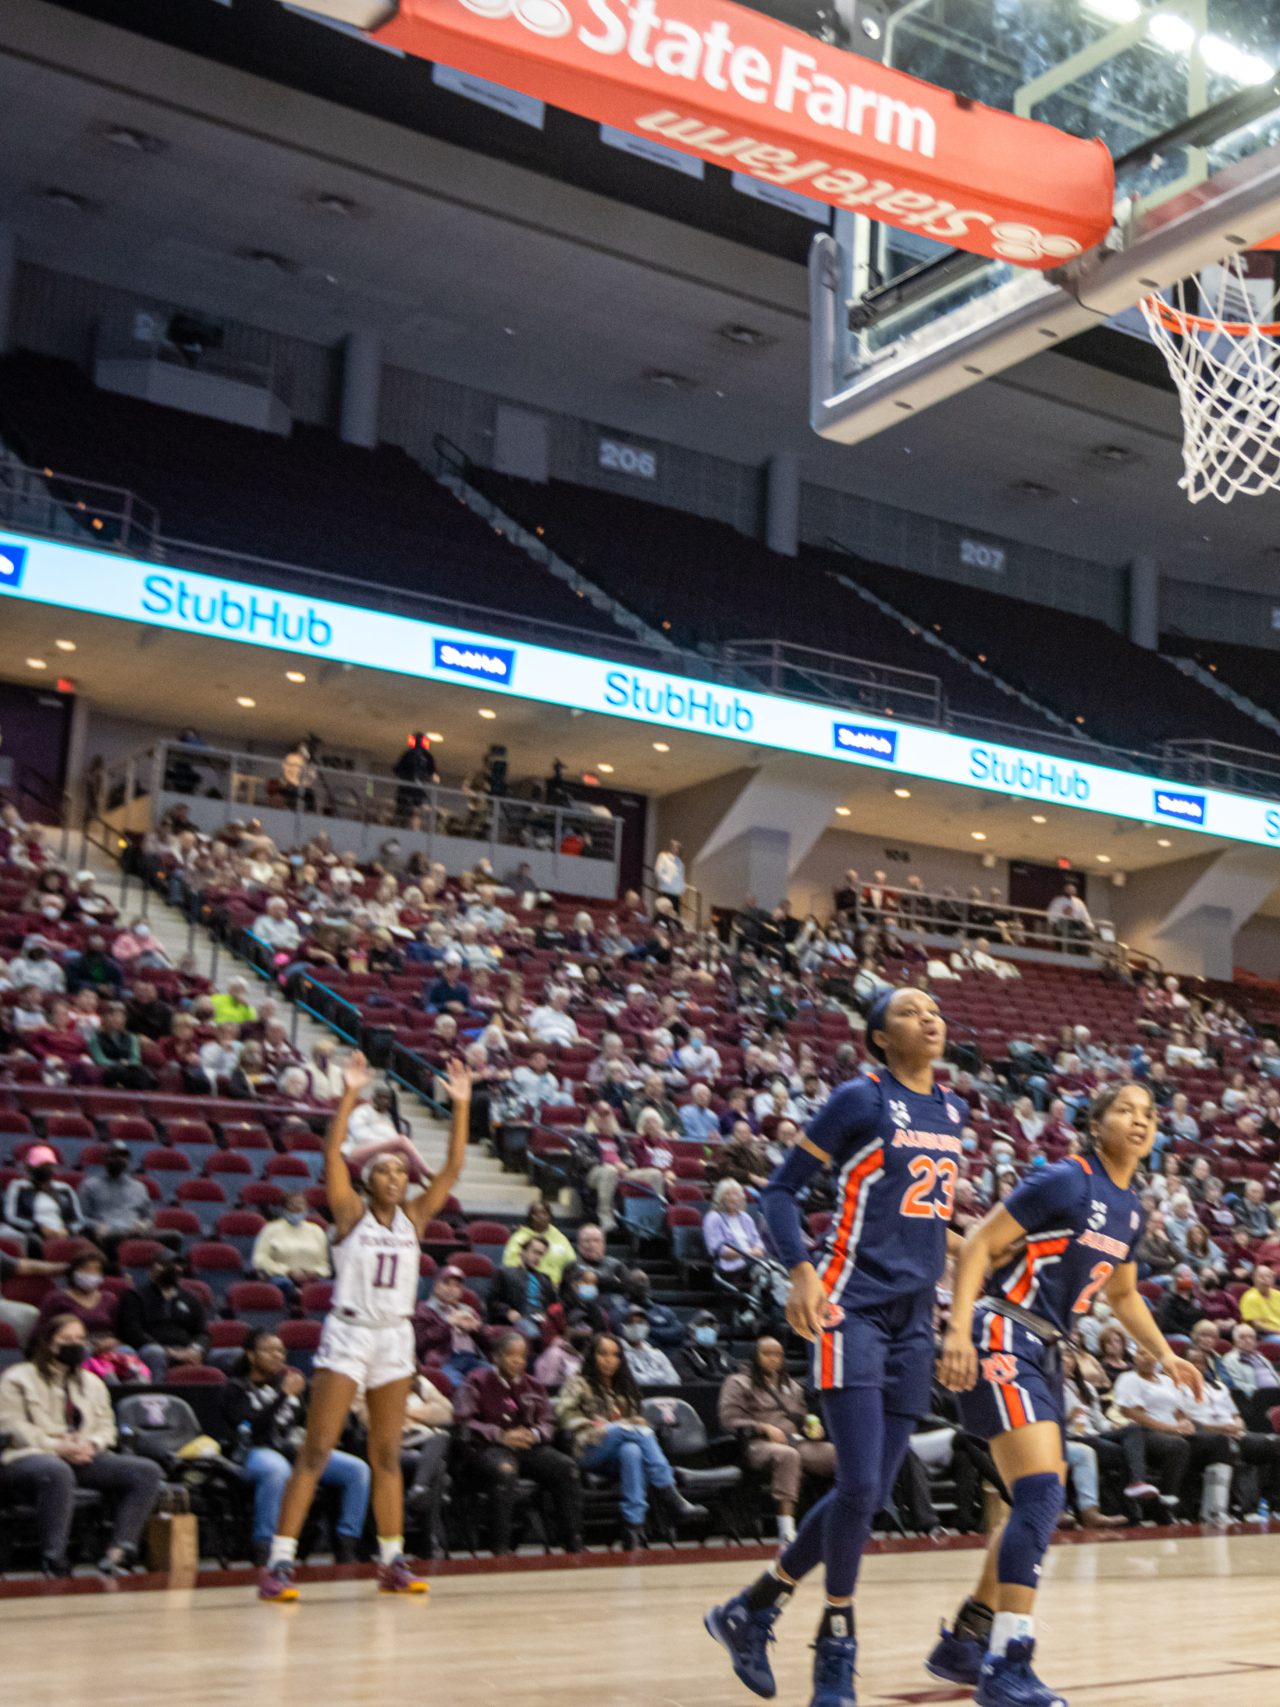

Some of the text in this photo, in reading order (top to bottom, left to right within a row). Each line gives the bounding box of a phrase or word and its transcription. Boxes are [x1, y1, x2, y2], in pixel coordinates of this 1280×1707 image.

[141, 574, 333, 647] StubHub
[603, 671, 755, 732] StubHub
[969, 748, 1091, 801] StubHub
[899, 1153, 960, 1221] 23
[371, 1251, 399, 1290] 11
